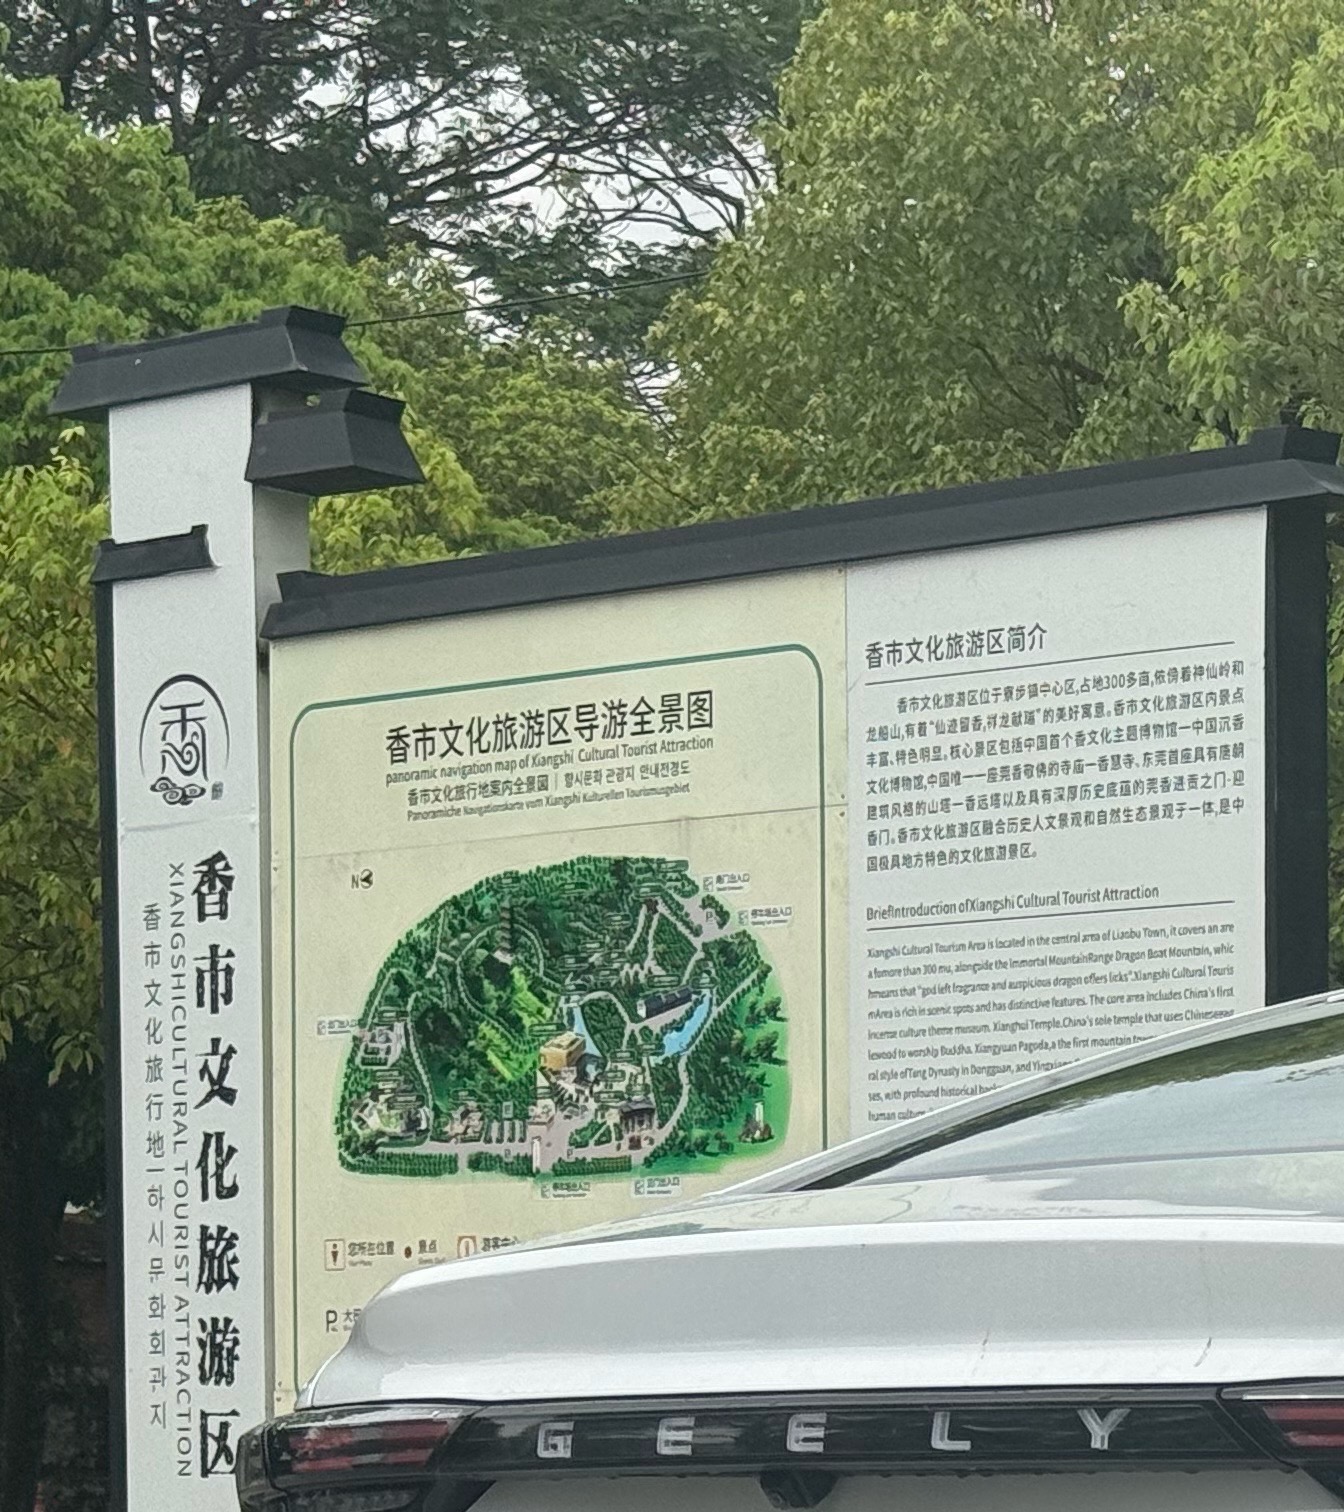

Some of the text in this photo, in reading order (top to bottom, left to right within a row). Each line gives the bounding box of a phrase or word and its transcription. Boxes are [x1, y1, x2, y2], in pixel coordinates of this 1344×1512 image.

[865, 622, 1048, 669] 香市文化旅游区简介
[385, 690, 713, 766] 香市文化旅游区导游全景图
[386, 735, 714, 787] panoramic navigation map of Xiangshi Cultural Tourist Attraction
[351, 874, 359, 889] N
[1016, 891, 1060, 908] Cultural
[1062, 889, 1101, 904] Tourist
[1103, 885, 1159, 902] Attraction
[192, 850, 239, 1478] 香市文化旅游区
[174, 1160, 189, 1288] TOURIST
[175, 1295, 192, 1477] ATTRACTION
[536, 1407, 1132, 1460] GEELY
